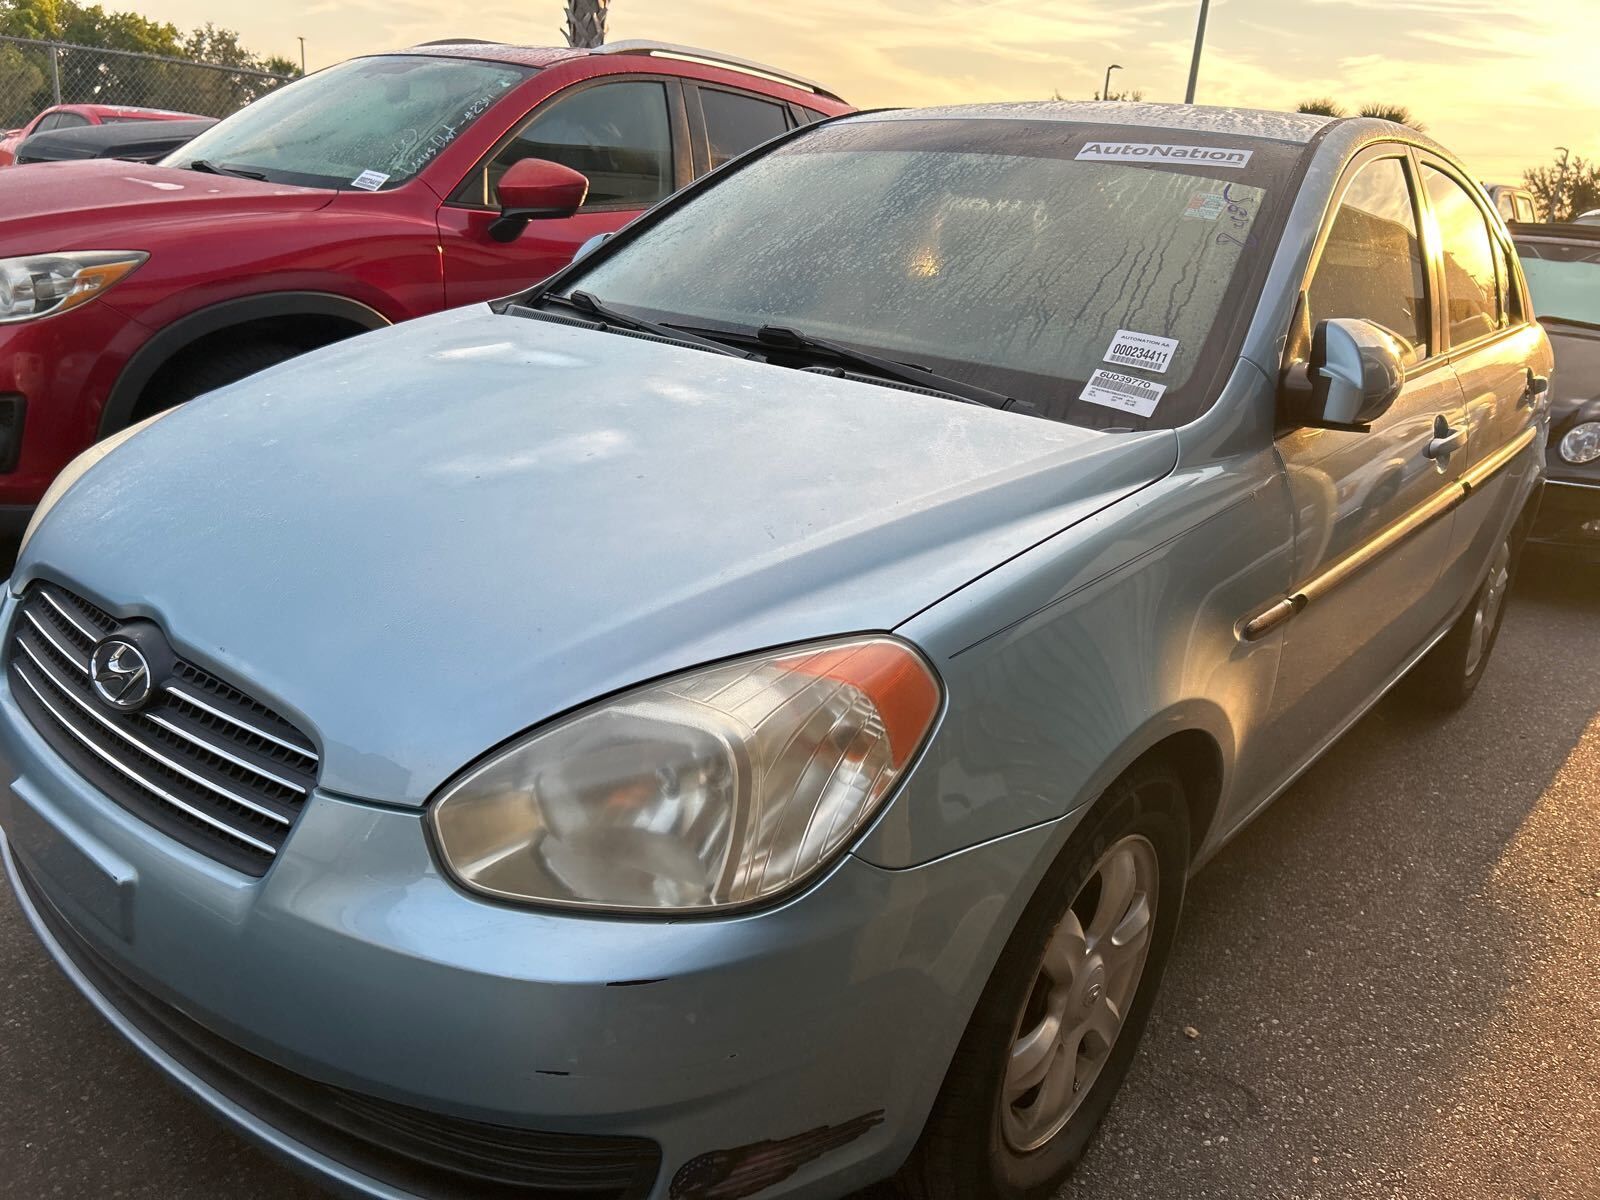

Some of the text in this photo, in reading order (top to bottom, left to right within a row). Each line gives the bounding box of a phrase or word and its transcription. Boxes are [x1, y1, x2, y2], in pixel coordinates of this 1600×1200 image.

[1080, 143, 1245, 162] AutoNation
[1120, 335, 1161, 346] AUTONATION
[1113, 343, 1168, 363] 000234411
[1099, 371, 1151, 389] 6U039770
